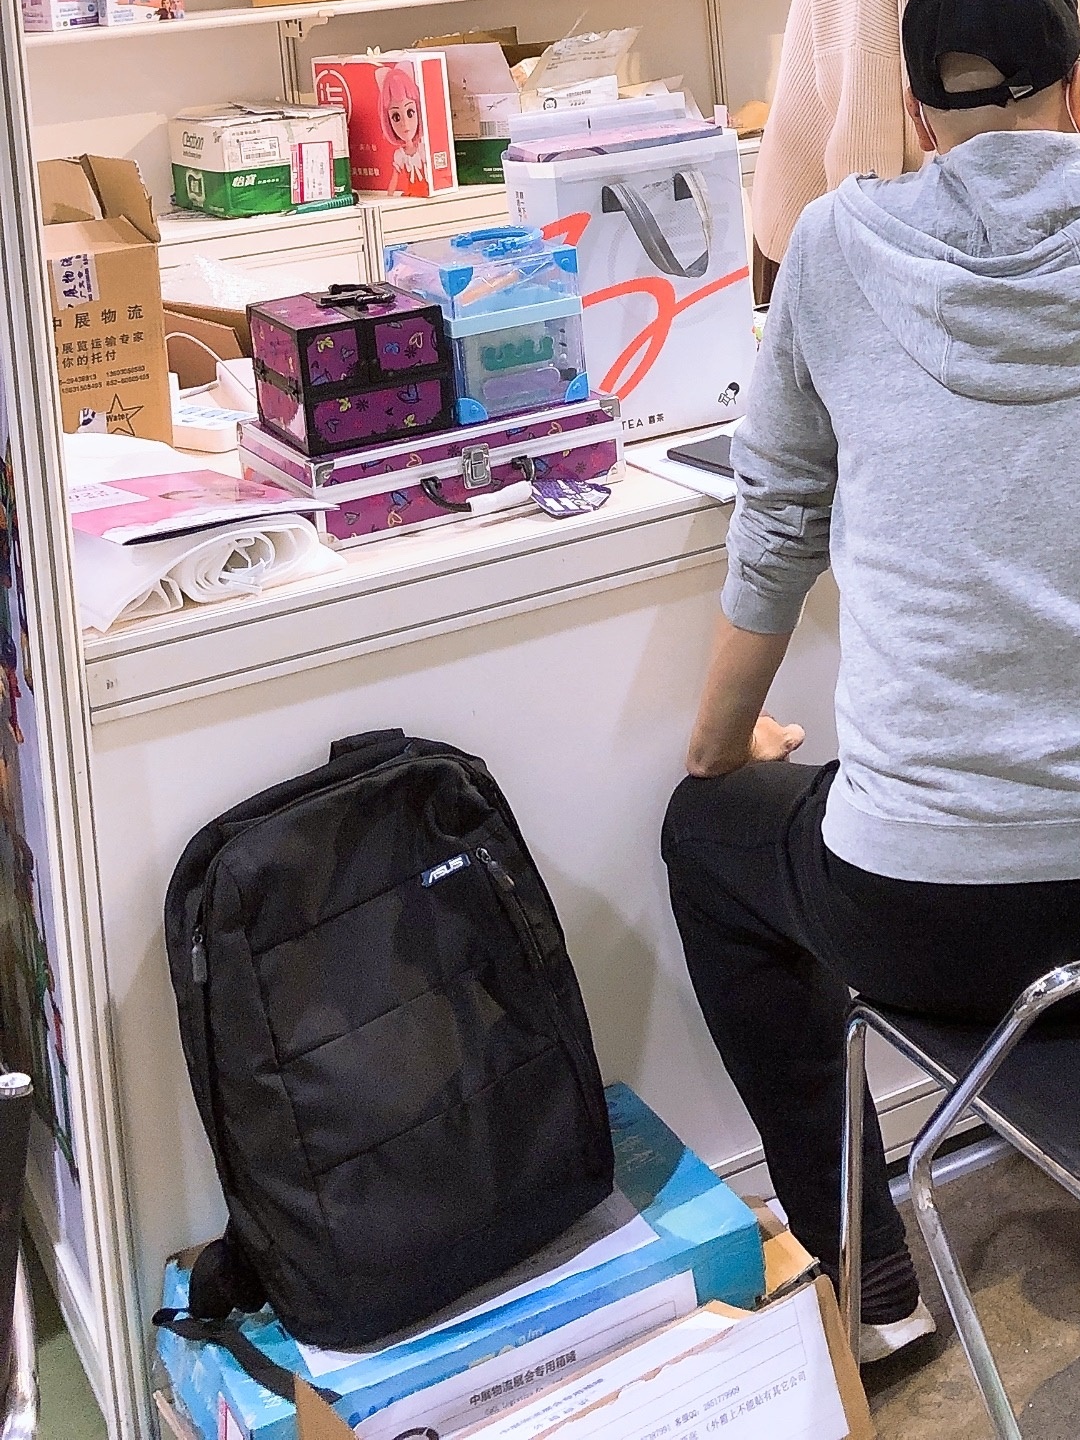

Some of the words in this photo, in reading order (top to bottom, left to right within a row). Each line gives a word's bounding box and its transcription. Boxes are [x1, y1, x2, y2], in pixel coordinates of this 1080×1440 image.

[57, 331, 145, 355] 展览运输专家
[428, 856, 464, 884] ASUS
